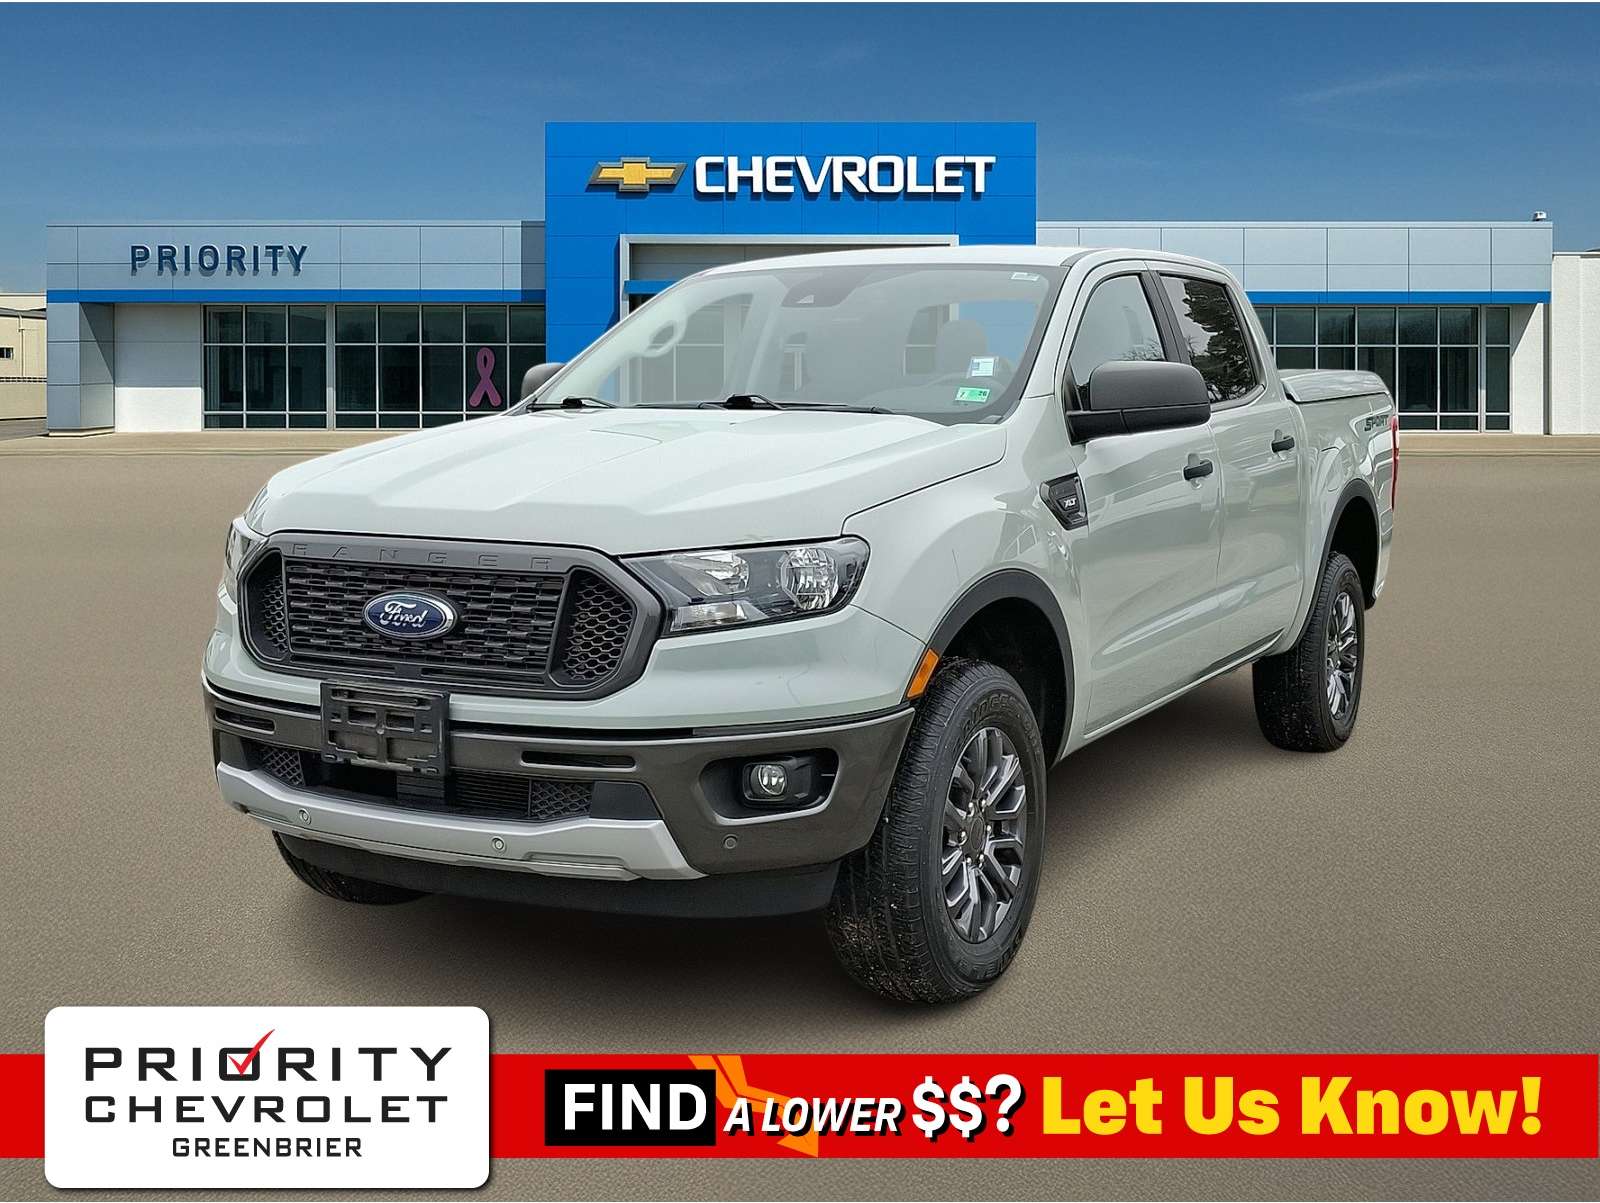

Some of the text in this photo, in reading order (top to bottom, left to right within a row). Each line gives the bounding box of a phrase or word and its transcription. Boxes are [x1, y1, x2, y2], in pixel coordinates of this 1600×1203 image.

[695, 155, 997, 195] CHEVROLET
[130, 245, 308, 273] PRIORITY
[292, 543, 552, 570] RANGER
[379, 600, 426, 629] Ford
